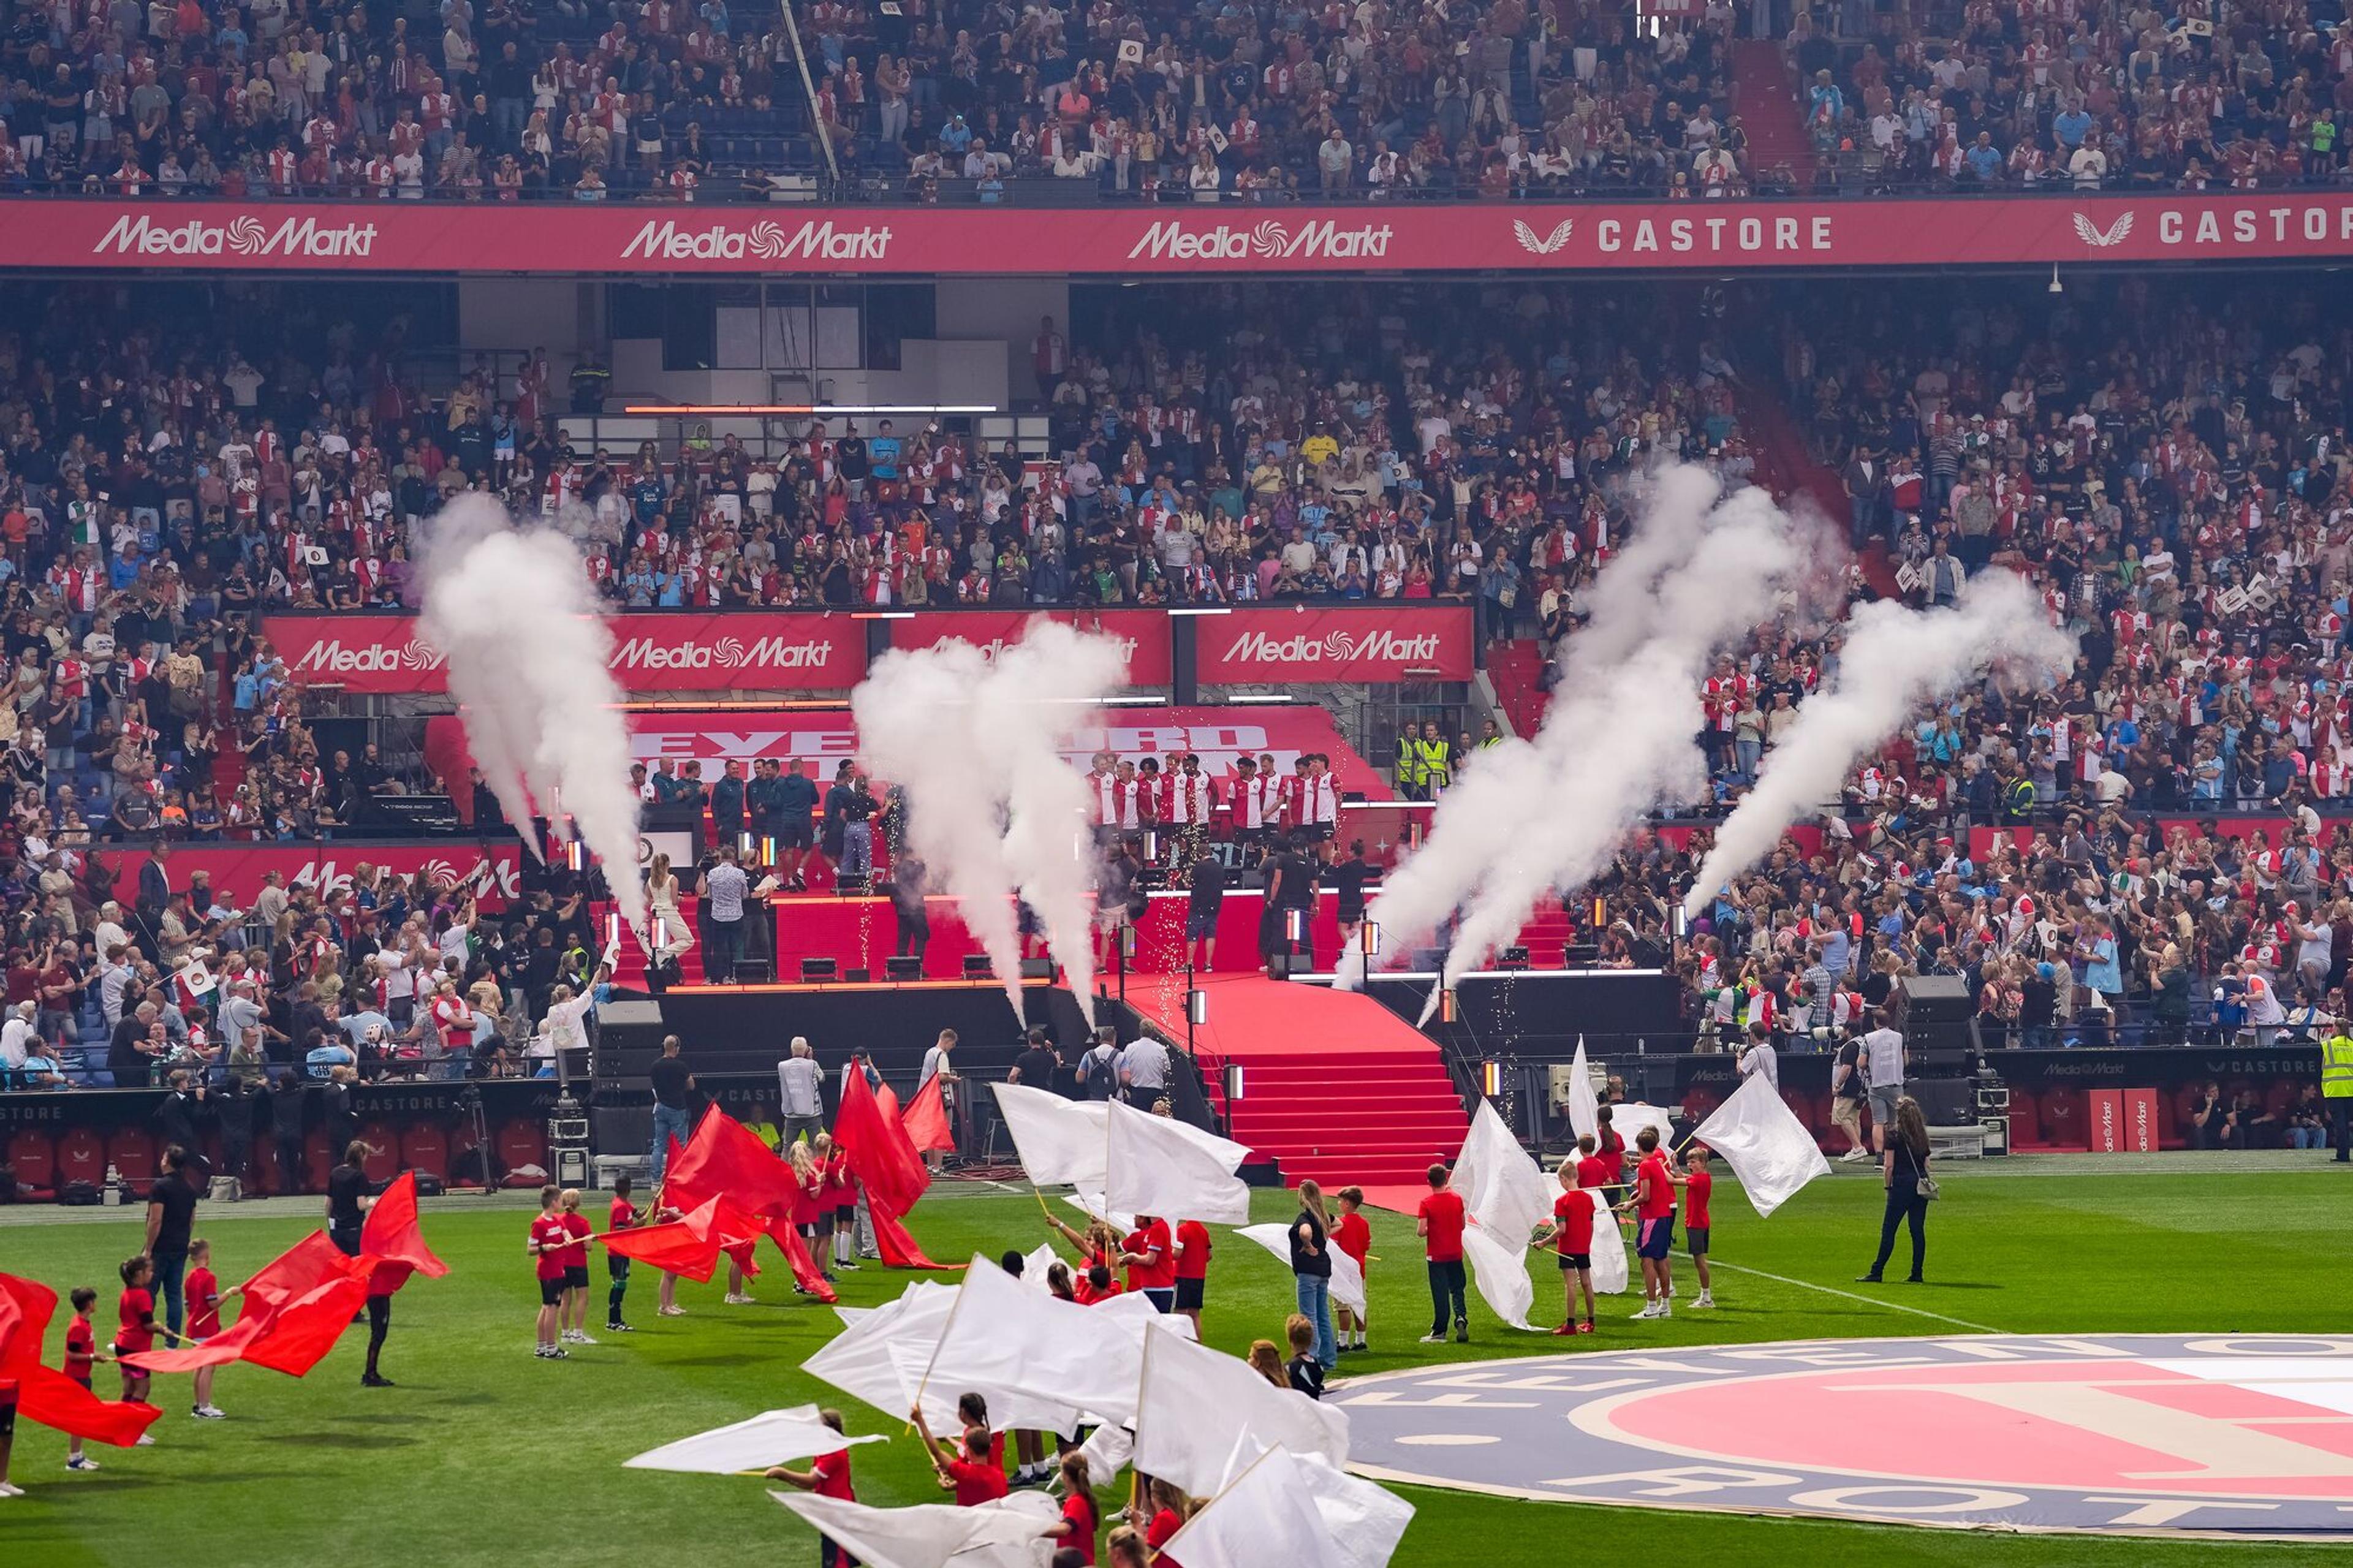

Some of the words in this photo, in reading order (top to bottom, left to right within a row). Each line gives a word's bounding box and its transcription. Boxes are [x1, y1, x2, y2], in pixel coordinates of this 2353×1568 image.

[93, 215, 224, 254] Media
[260, 218, 377, 256] Markt
[621, 221, 746, 259] Media
[780, 221, 892, 259] Markt
[1128, 221, 1249, 259] Media
[1284, 221, 1393, 257] Markt
[1598, 218, 1832, 252] CASTORE
[293, 639, 400, 671] Media
[607, 637, 710, 669] Media
[741, 636, 832, 668] Markt
[1222, 631, 1322, 662] Media
[1349, 631, 1440, 661] Markt
[1690, 1069, 1729, 1081] Media
[2044, 1062, 2082, 1075] Media
[2092, 1062, 2124, 1074] Markt
[2232, 1061, 2316, 1073] CASTORE
[356, 1096, 447, 1110] CASTORE
[728, 1088, 776, 1103] CAST
[2102, 1100, 2112, 1129] Markt
[2137, 1100, 2146, 1129] Markt
[1538, 1466, 2353, 1526] ROT
